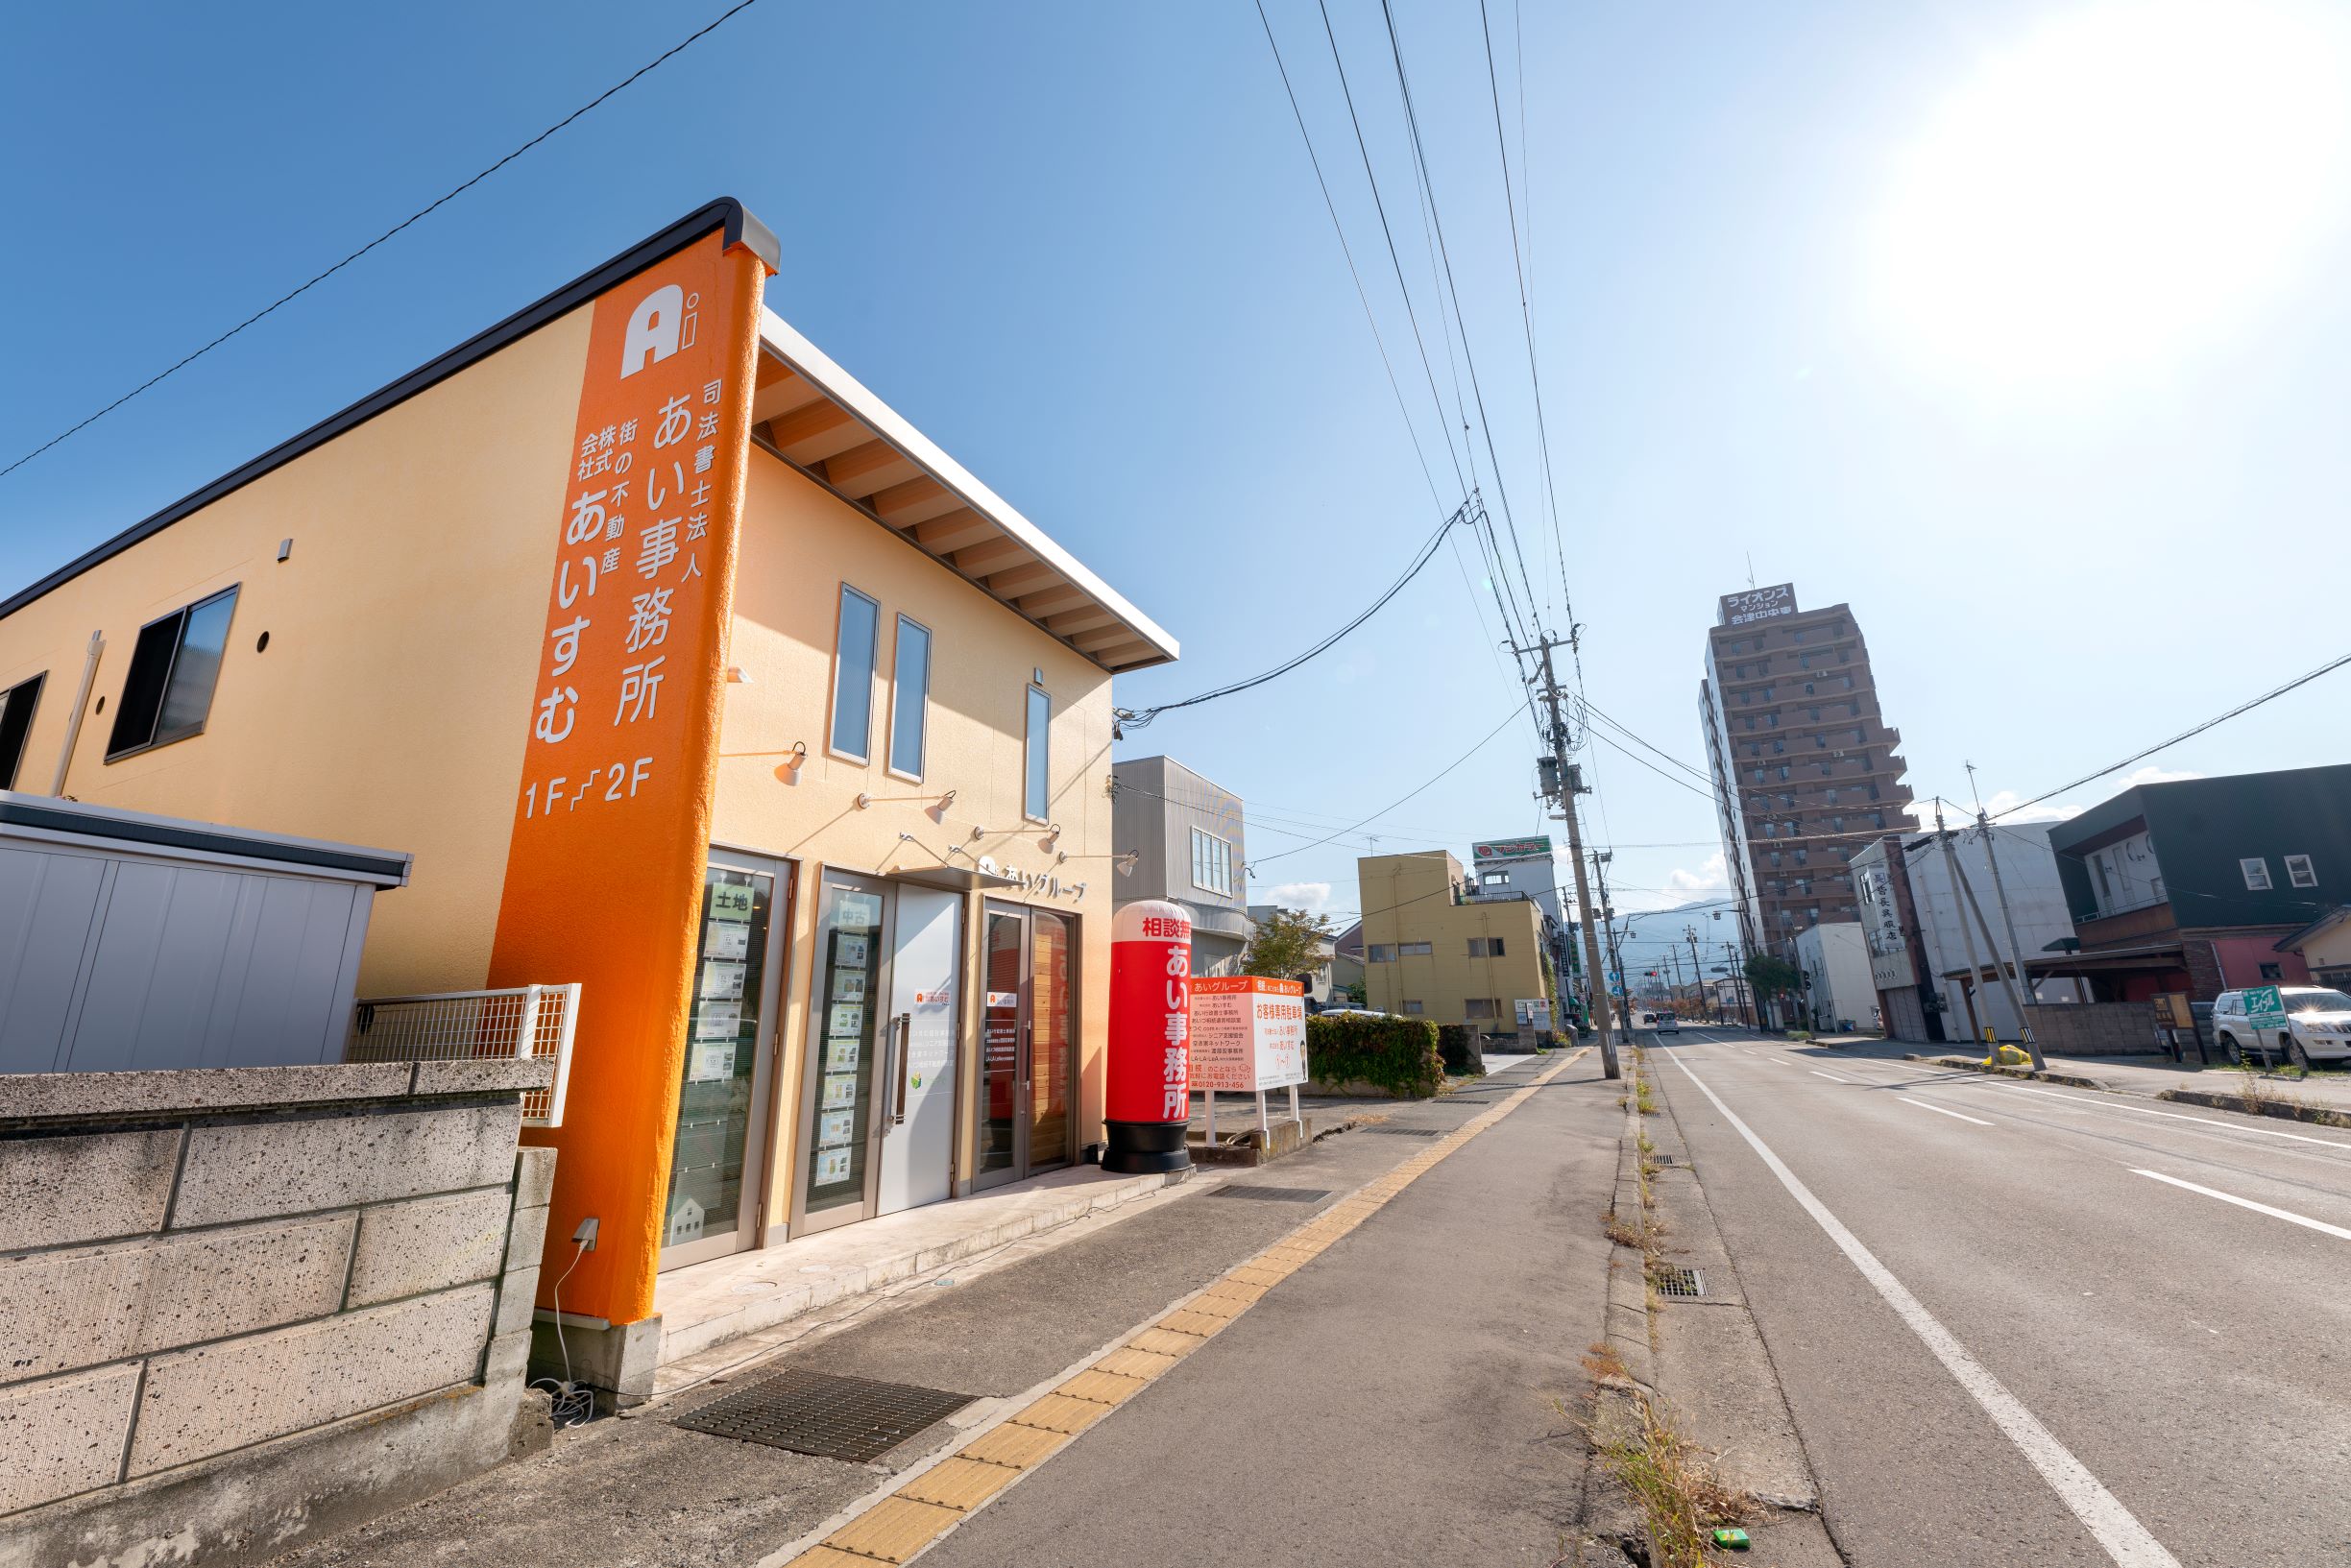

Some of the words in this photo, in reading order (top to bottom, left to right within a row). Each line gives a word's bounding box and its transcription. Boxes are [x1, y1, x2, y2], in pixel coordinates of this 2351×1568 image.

[681, 380, 722, 583] 司法書士法人
[600, 418, 639, 575] 街の不動産
[614, 397, 691, 727] あい事務所
[1727, 586, 1789, 608] ライオンズ
[1740, 600, 1779, 613] マンション
[536, 489, 606, 744] あいすむ
[715, 891, 749, 912] 土地
[842, 908, 865, 925] 中古
[1194, 979, 1248, 993] あいグループ
[1256, 1003, 1303, 1021] お客様専用駐車場
[1163, 945, 1189, 1120] あい事務所
[1199, 1080, 1245, 1089] 0120-913-456
